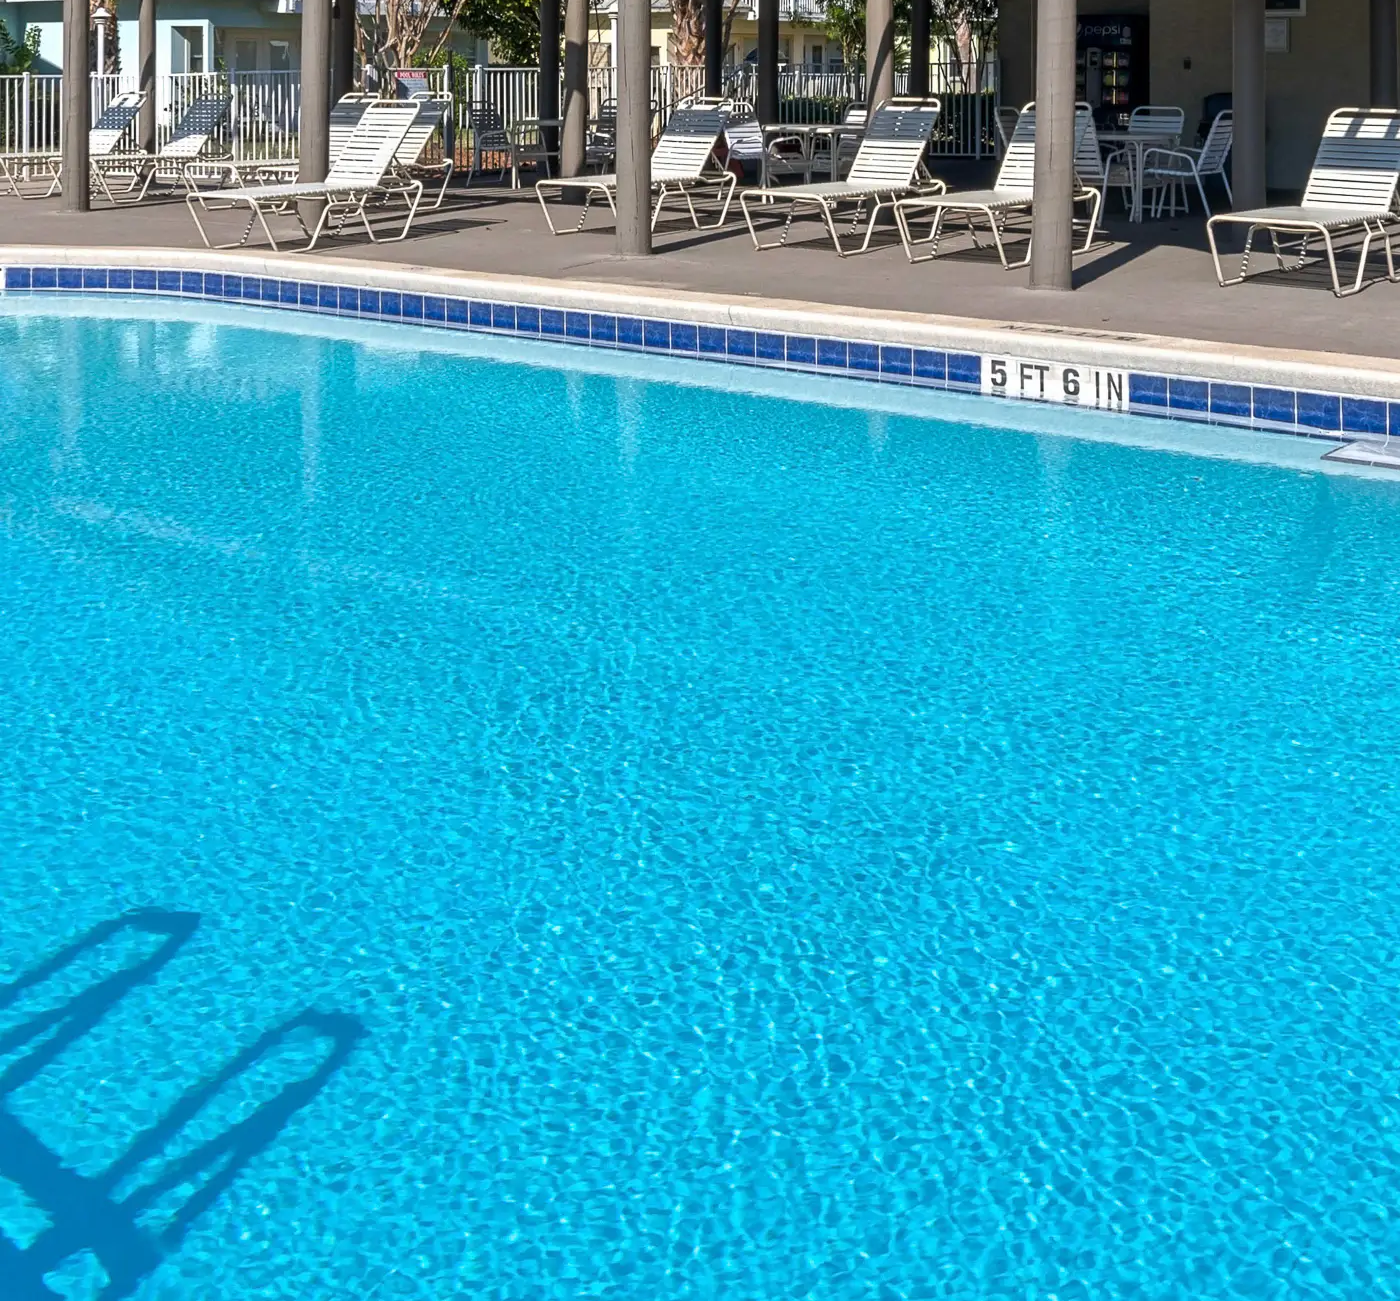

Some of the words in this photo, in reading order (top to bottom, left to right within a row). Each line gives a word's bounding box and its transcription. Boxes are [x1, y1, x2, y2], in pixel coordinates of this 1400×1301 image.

[1085, 24, 1120, 36] pepsi
[990, 359, 1007, 387] 5
[1020, 363, 1049, 392] FT
[1062, 368, 1080, 396] 6
[1095, 371, 1122, 401] IN
